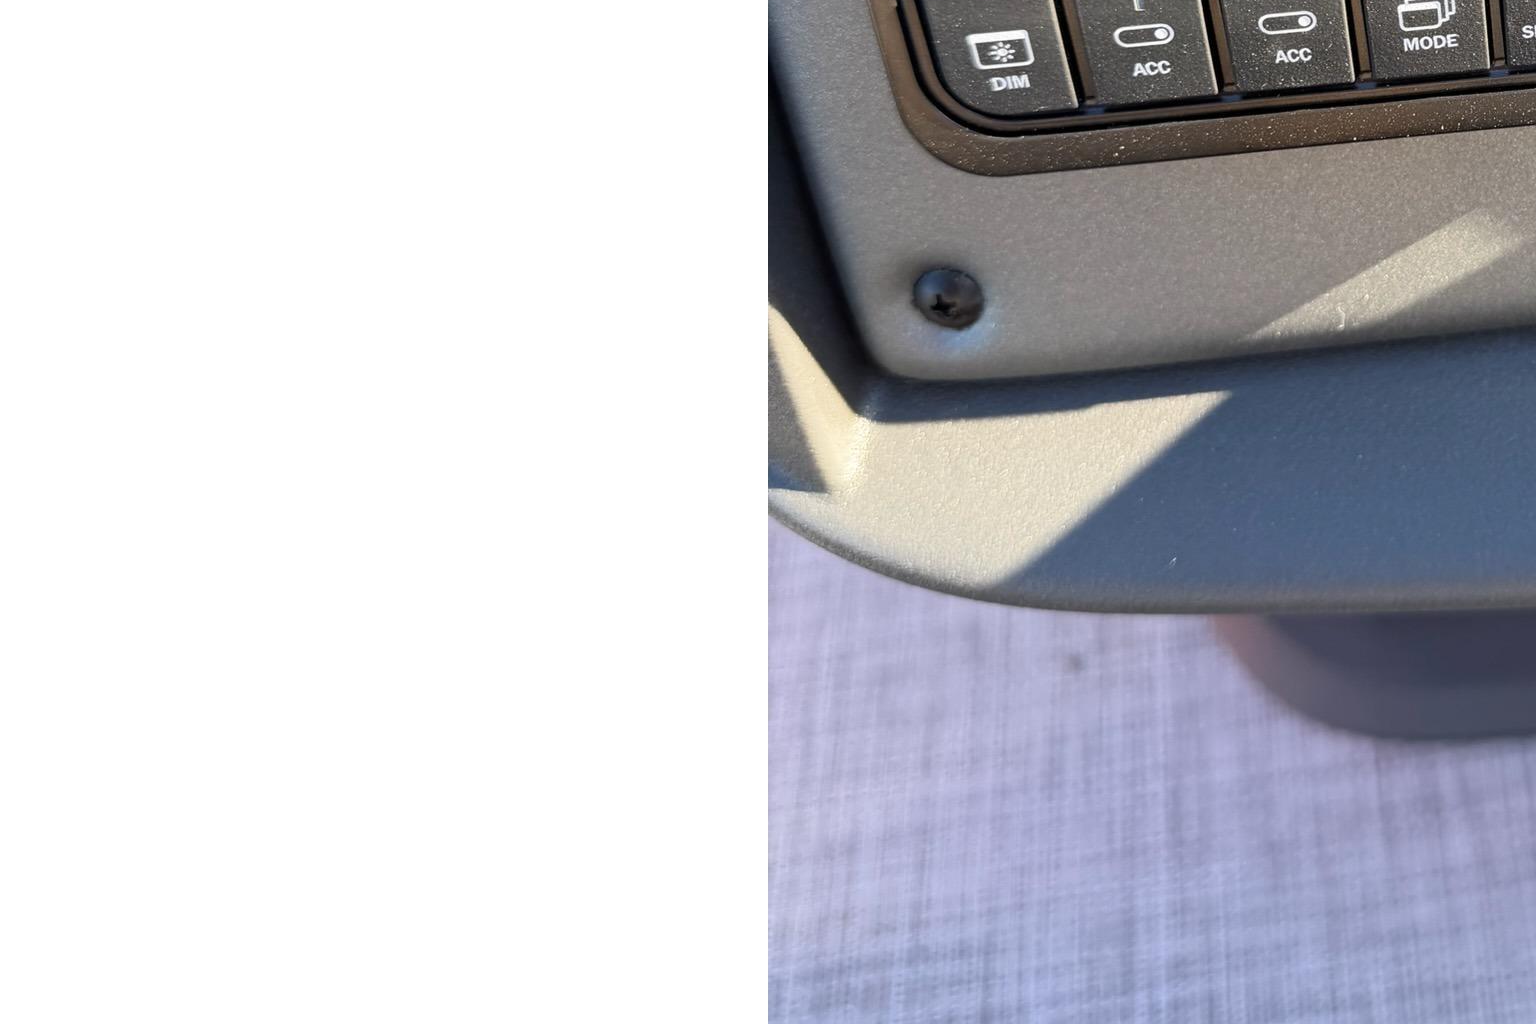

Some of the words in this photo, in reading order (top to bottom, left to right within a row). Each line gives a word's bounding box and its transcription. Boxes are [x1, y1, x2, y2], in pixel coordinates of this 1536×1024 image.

[1403, 33, 1459, 52] MODE
[1275, 47, 1312, 64] ACC
[1132, 59, 1172, 77] ACC
[988, 74, 1031, 92] DIM
